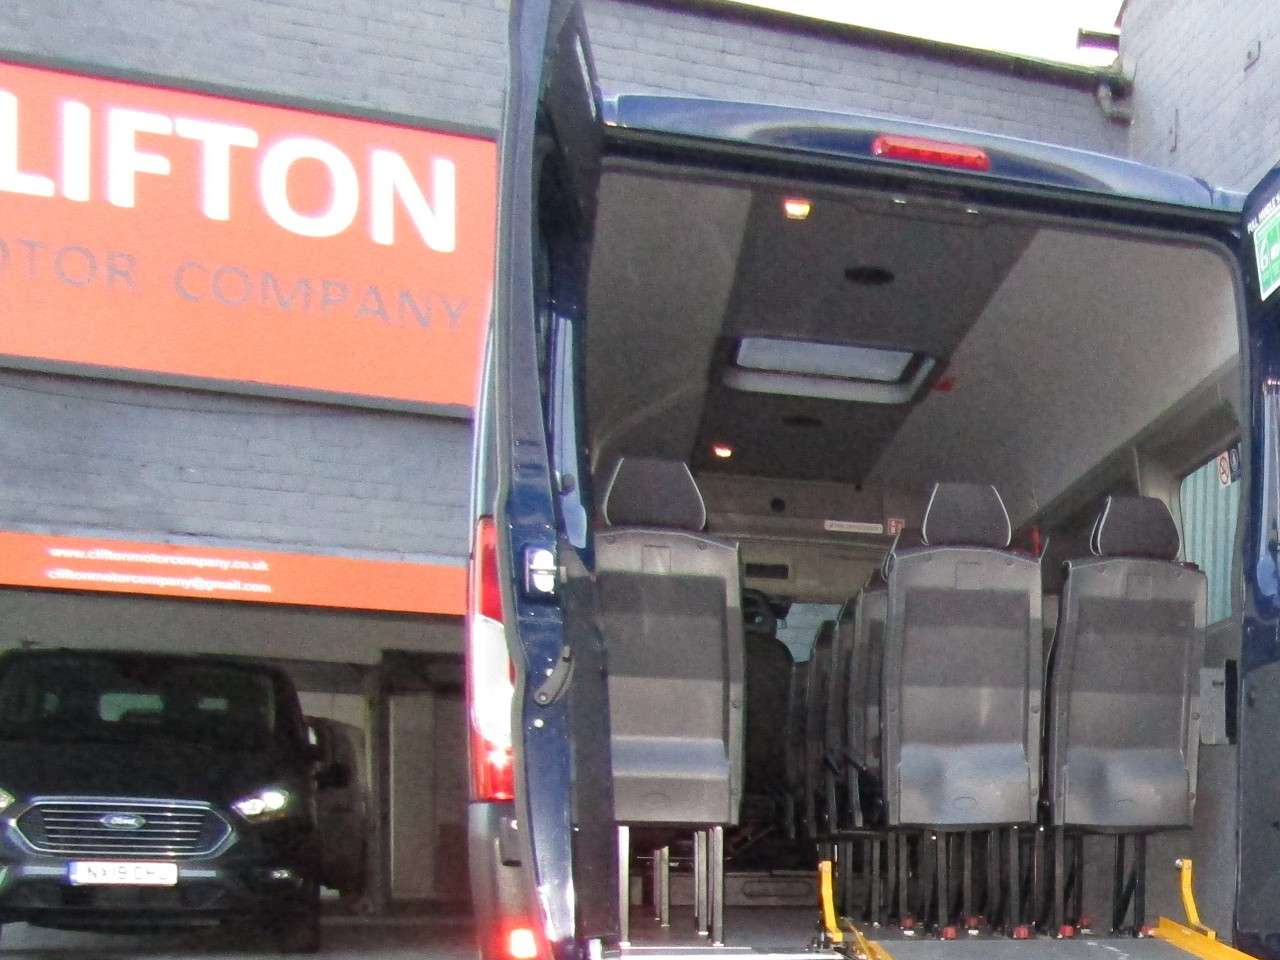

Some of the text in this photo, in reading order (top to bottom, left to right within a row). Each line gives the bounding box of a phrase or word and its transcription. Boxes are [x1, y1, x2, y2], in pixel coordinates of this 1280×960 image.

[0, 92, 456, 252] LIFTON
[0, 239, 468, 330] TOR COMPANY
